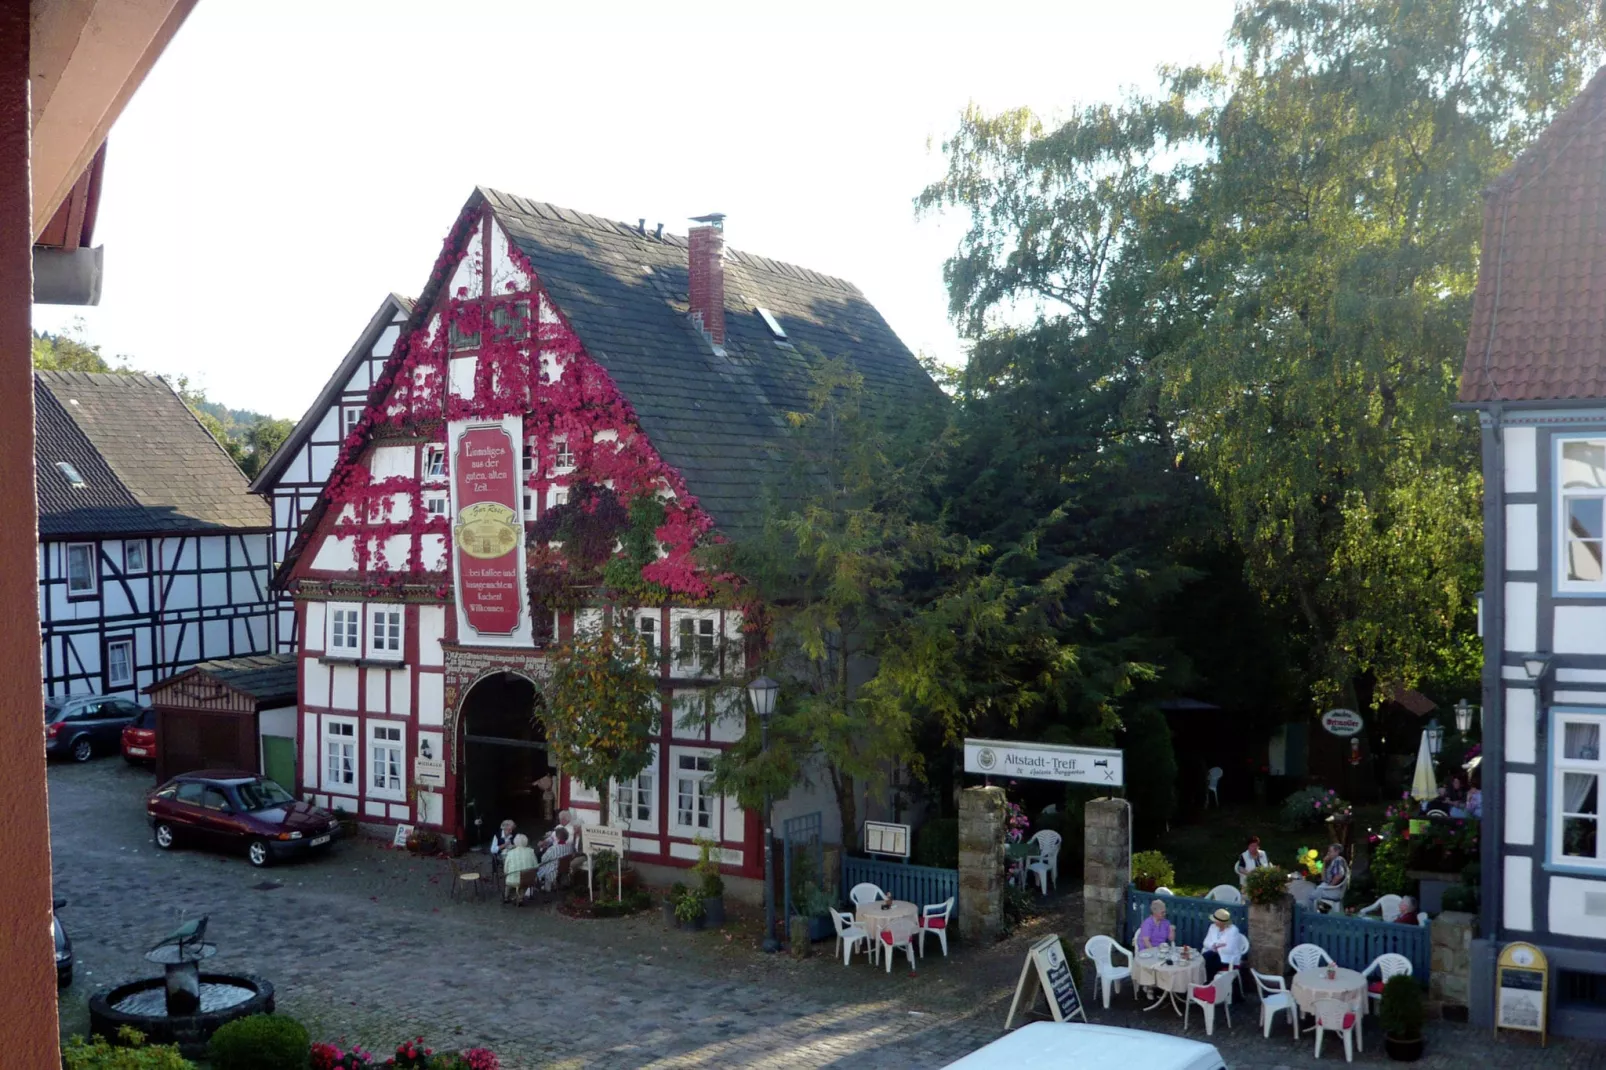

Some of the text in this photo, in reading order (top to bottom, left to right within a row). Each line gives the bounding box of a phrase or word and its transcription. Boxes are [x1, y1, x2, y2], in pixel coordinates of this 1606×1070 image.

[471, 458, 499, 469] aus der
[488, 469, 507, 480] alten
[481, 568, 502, 577] Kaffee
[503, 568, 516, 577] und
